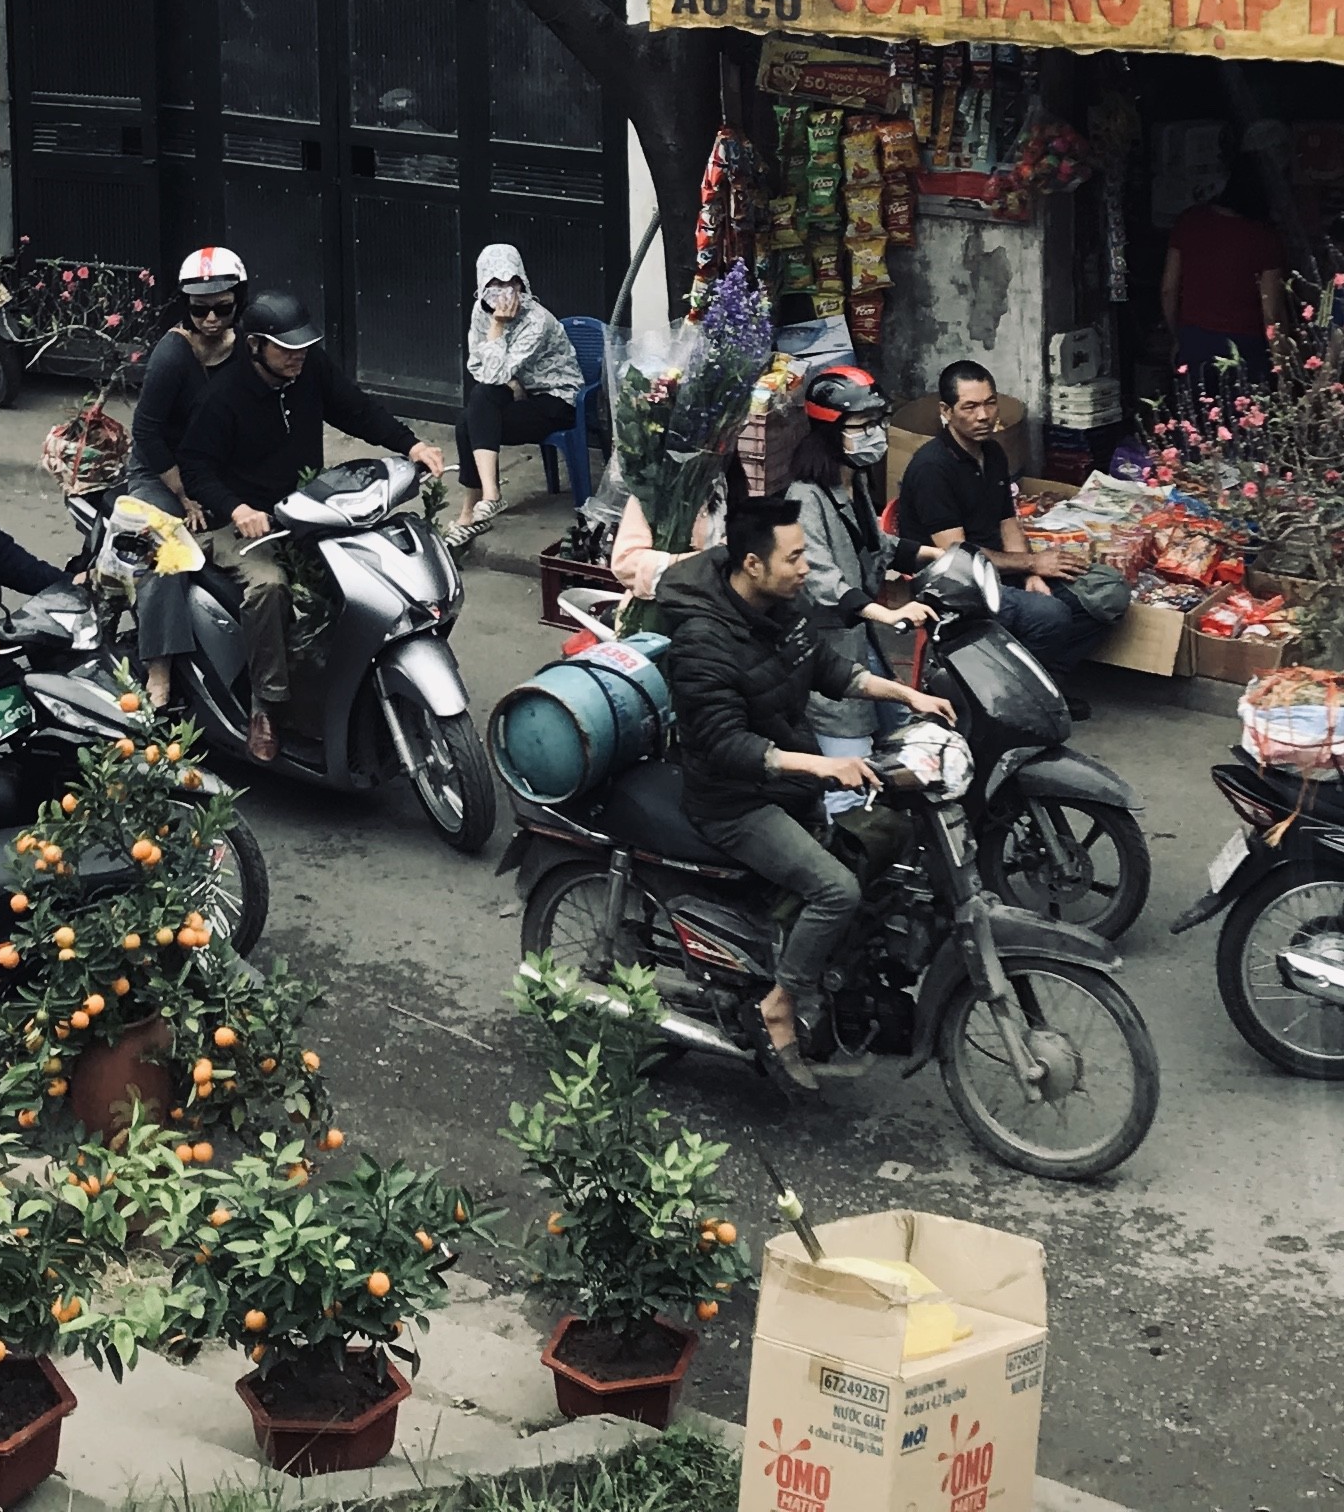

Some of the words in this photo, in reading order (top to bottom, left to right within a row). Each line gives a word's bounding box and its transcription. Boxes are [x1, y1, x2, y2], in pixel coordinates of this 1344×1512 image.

[4, 705, 31, 724] Gra
[825, 1374, 885, 1404] 67249287
[776, 1454, 831, 1501] OMO
[950, 1441, 994, 1497] OMO
